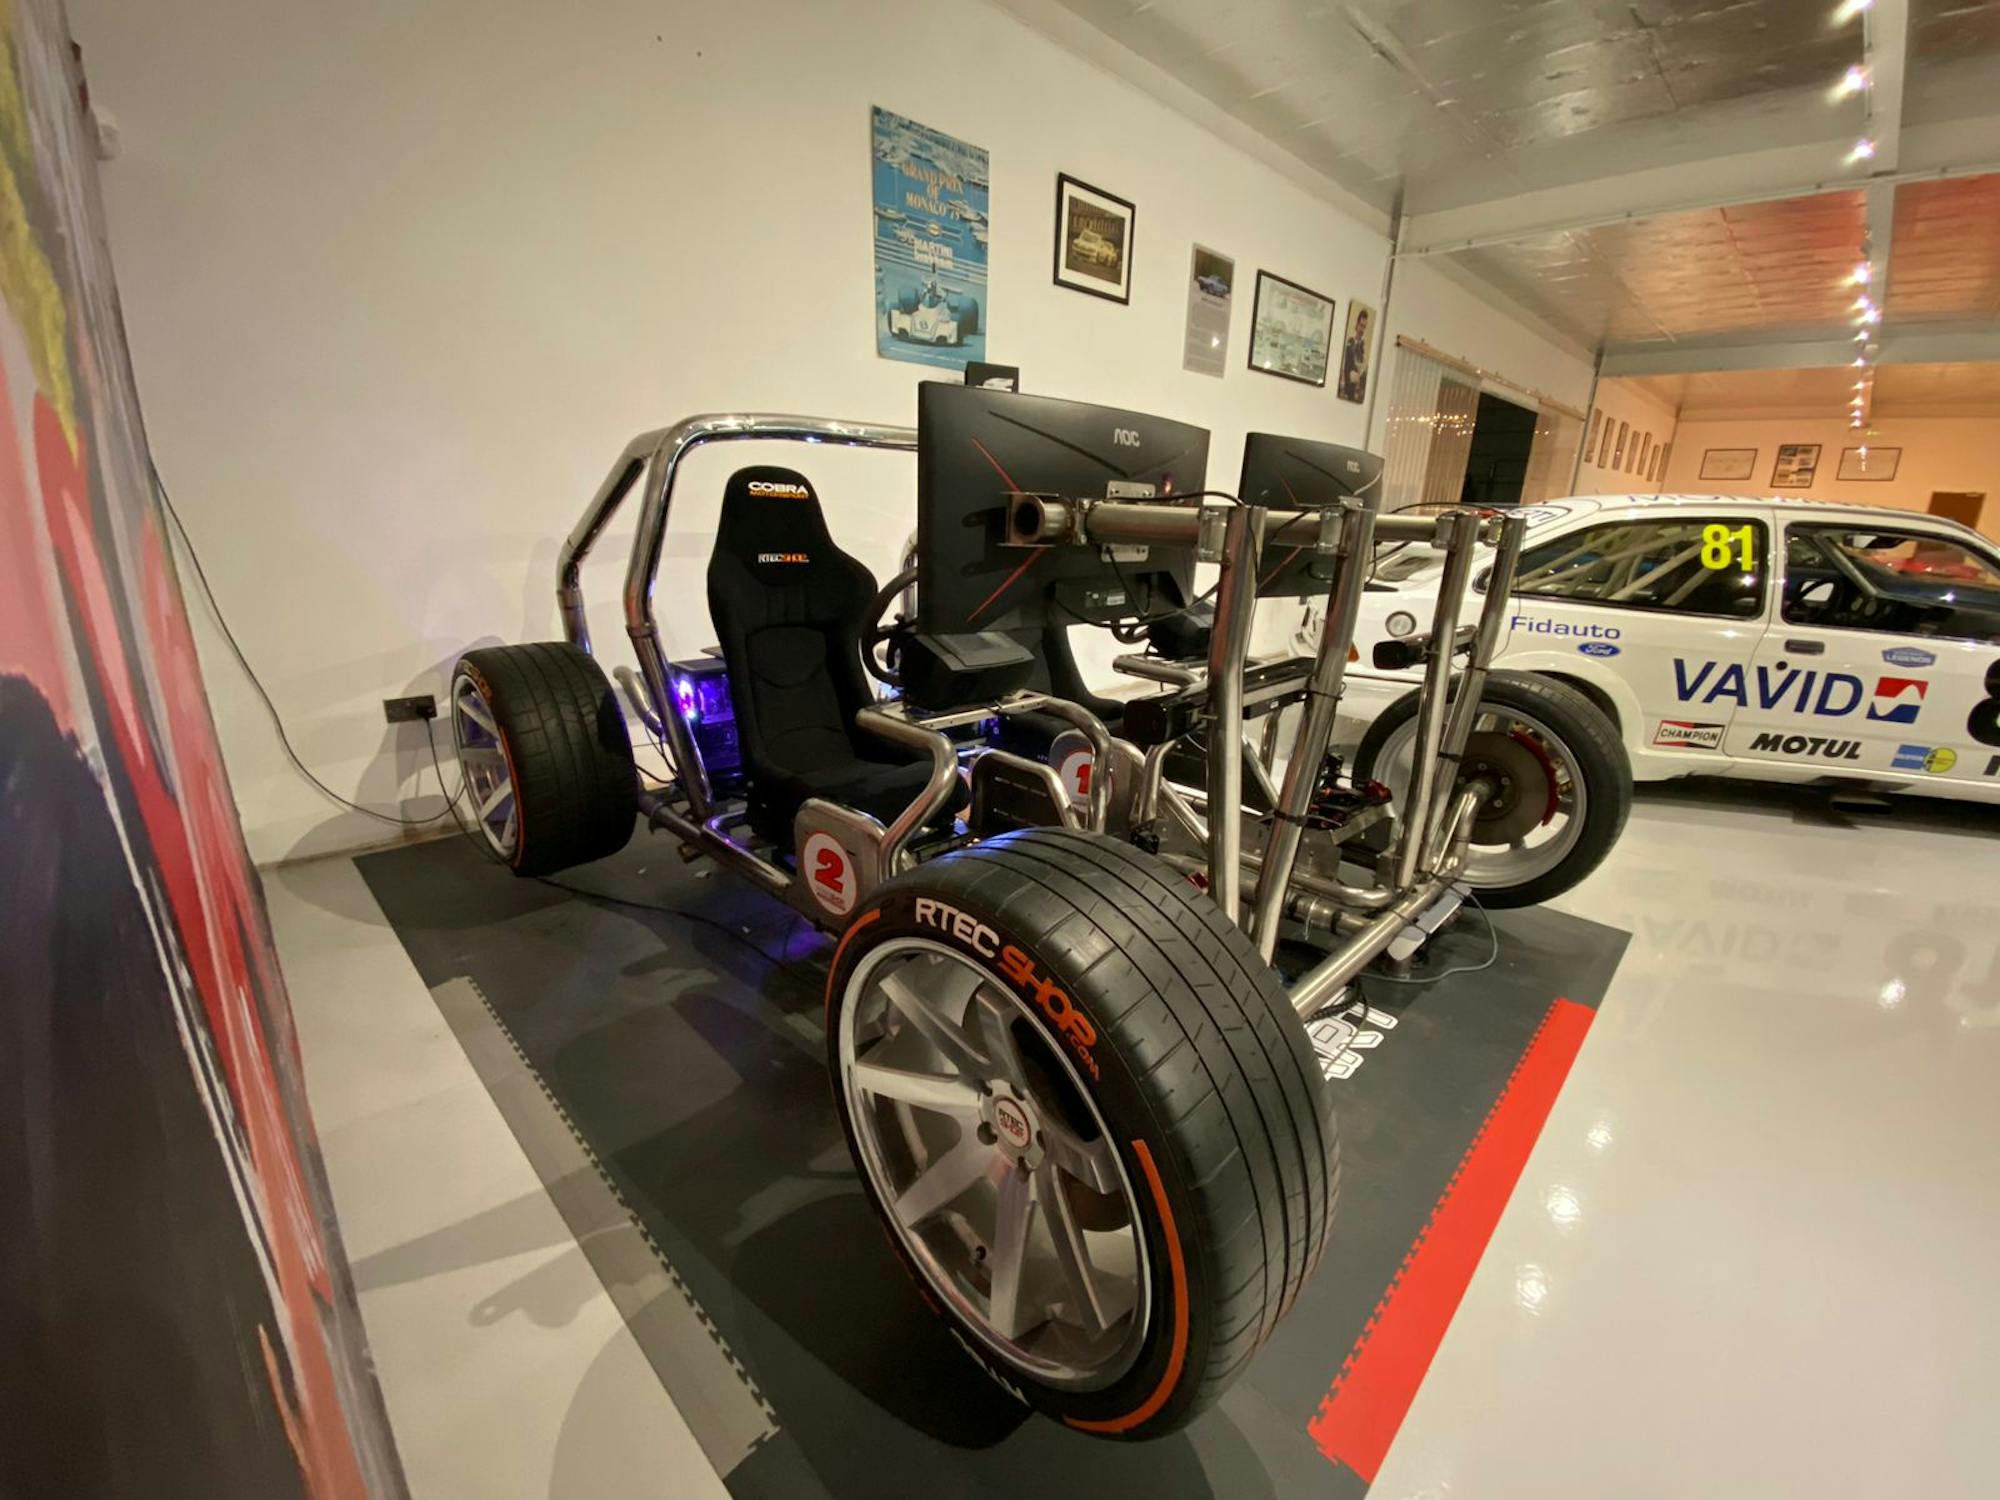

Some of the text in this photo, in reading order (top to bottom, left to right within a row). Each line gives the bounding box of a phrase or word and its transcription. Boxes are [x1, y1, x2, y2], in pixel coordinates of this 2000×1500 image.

[1114, 428, 1141, 447] AOC
[748, 481, 809, 494] COBRA
[1701, 524, 1753, 572] 81
[1511, 616, 1621, 640] Fidauto
[1674, 658, 1864, 716] VAVID
[1660, 728, 1719, 743] CHAMPION
[1749, 733, 1862, 760] MOTUL
[815, 848, 844, 894] 2
